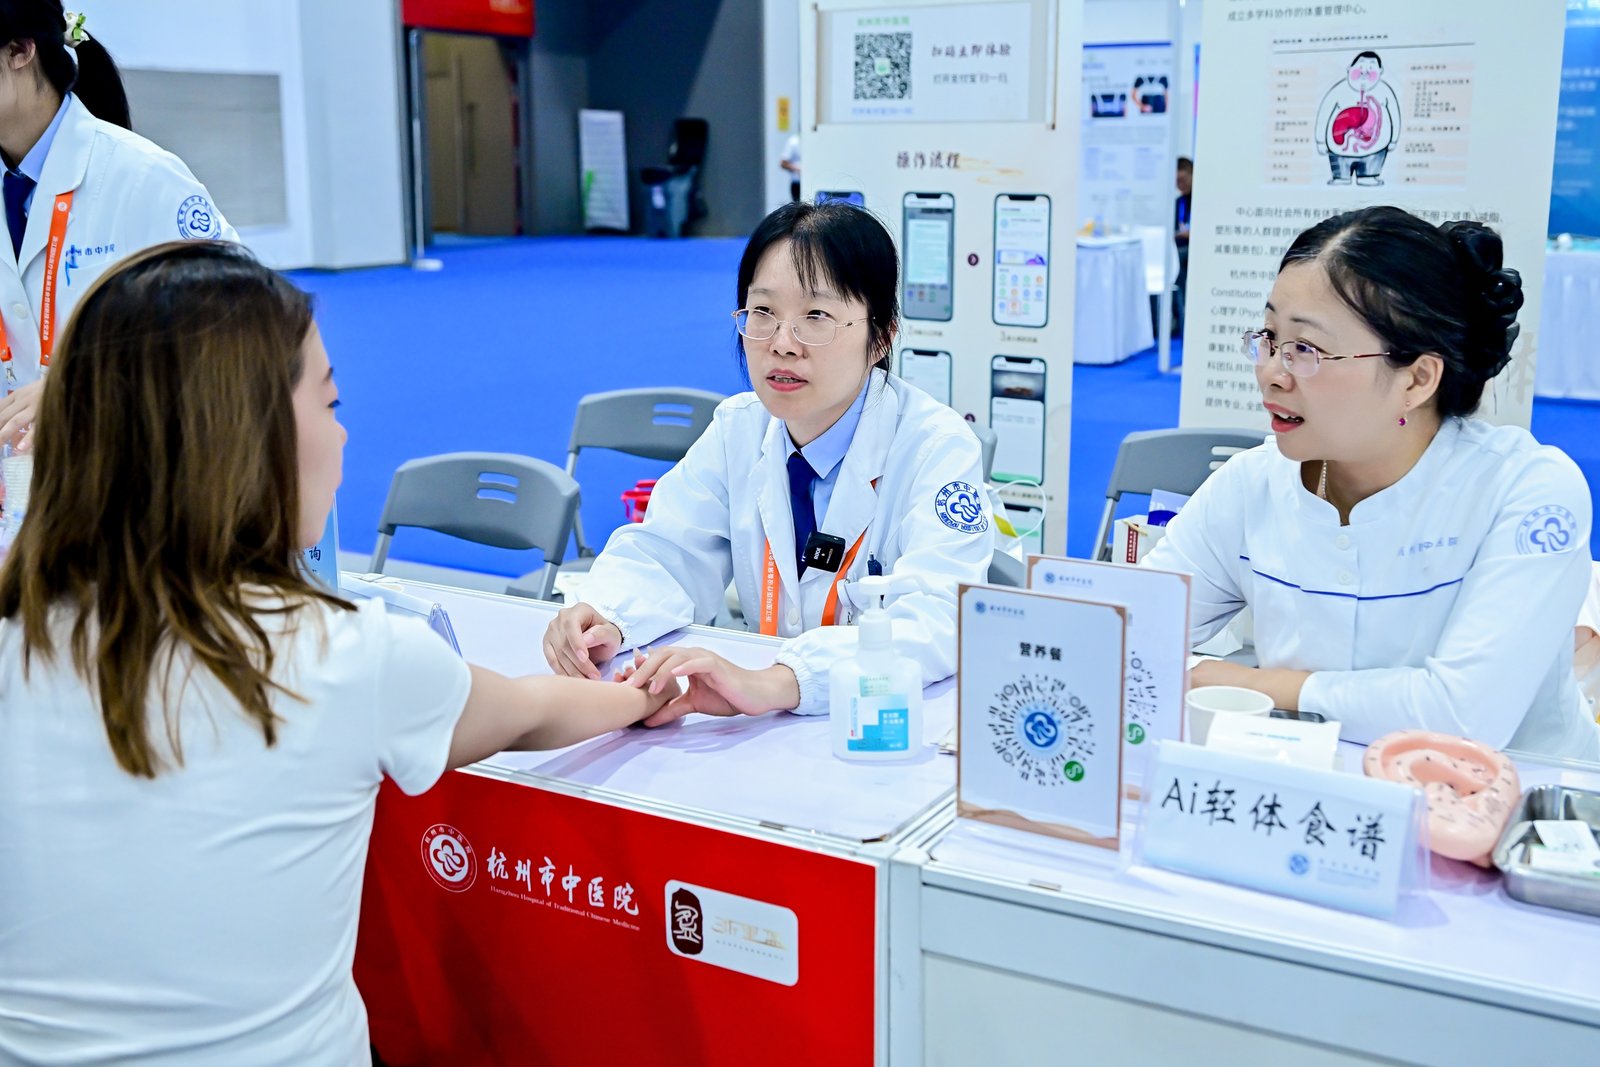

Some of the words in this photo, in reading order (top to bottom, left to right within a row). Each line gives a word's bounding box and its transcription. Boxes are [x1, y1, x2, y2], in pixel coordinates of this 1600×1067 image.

[897, 151, 960, 168] 操作流程
[1211, 287, 1262, 298] Constitution
[1019, 642, 1063, 661] 营养餐
[486, 846, 640, 916] 杭州市中医院
[490, 885, 519, 899] Hangzhou
[520, 893, 545, 905] Hospital
[553, 902, 586, 917] Traditional
[586, 911, 610, 923] Chinese
[612, 918, 640, 931] Medicine
